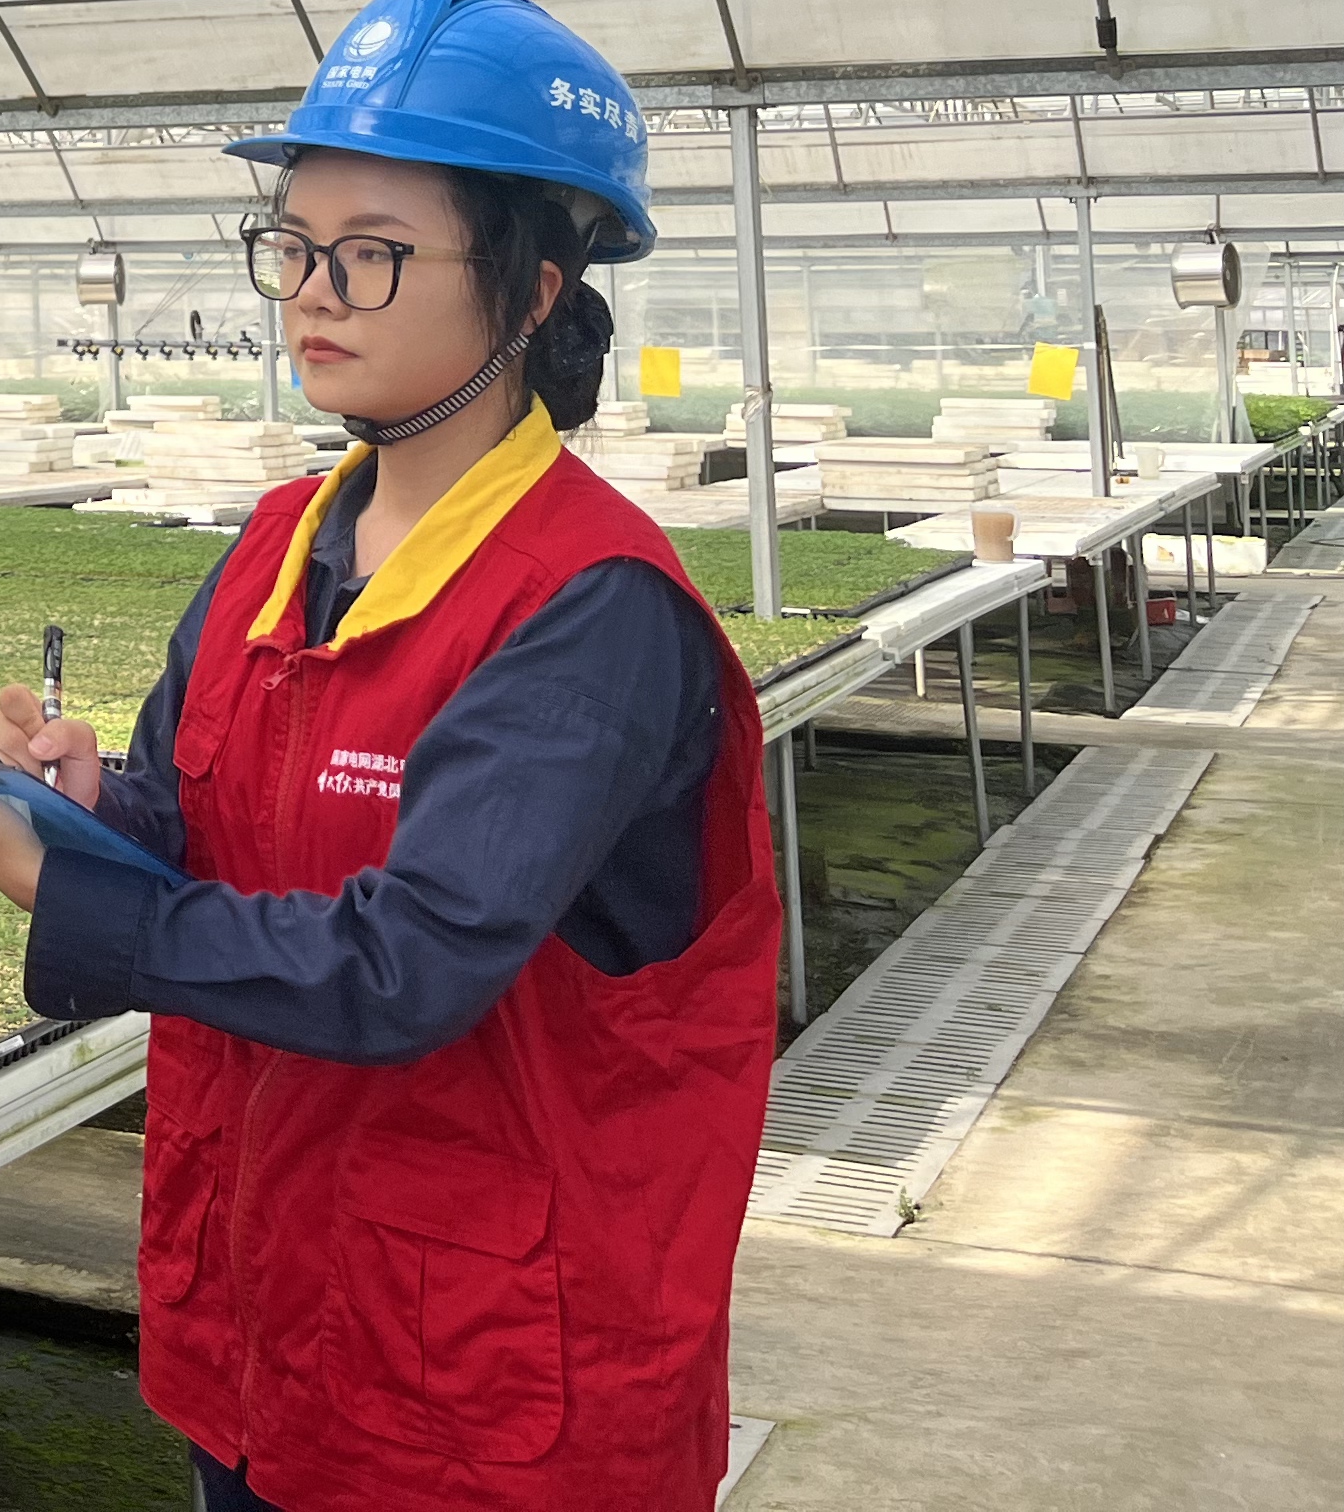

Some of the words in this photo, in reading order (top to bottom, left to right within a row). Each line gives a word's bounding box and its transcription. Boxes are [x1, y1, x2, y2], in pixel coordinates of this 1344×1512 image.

[325, 65, 379, 81] 国家电网
[548, 77, 639, 144] 务实尽责
